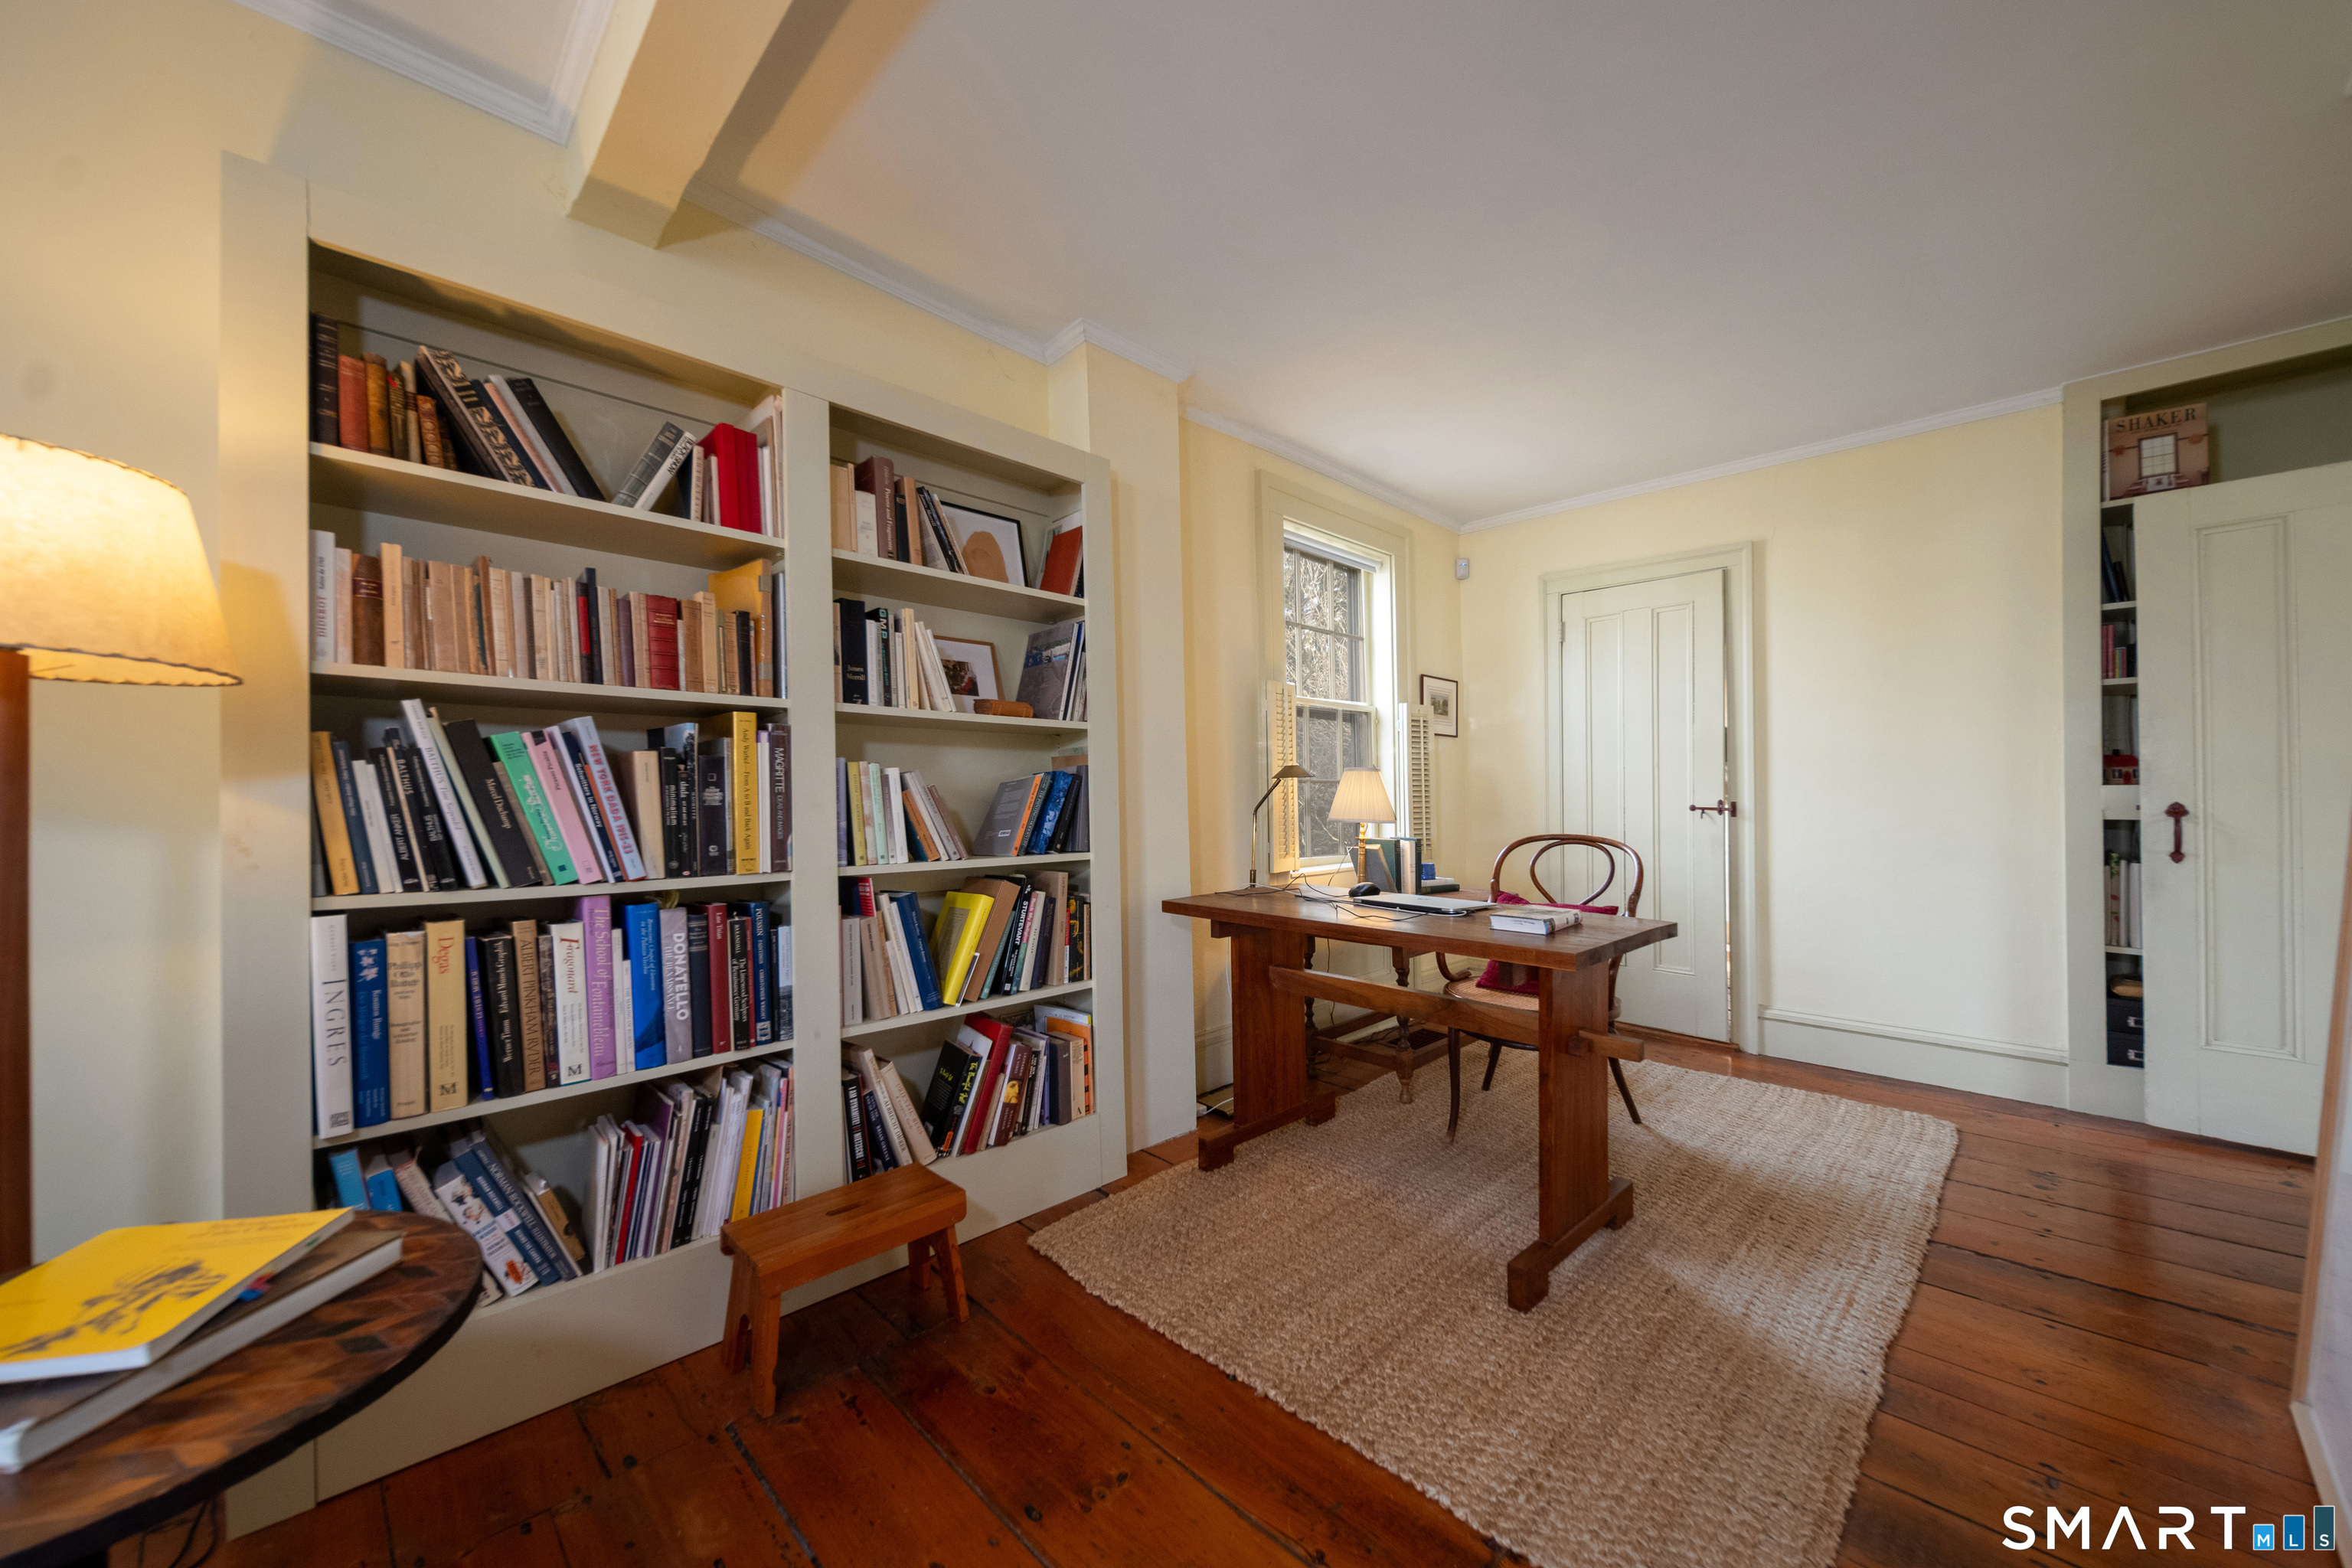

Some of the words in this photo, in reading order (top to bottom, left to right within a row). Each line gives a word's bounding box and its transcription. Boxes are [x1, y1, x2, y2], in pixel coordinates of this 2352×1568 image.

[2115, 407, 2197, 433] SHAKER
[676, 436, 694, 458] BLACK
[665, 455, 682, 475] SNOW
[883, 487, 892, 507] Poems
[924, 508, 937, 527] Merrill
[884, 520, 894, 550] Fragments
[315, 596, 327, 636] DIDEROT
[741, 727, 750, 743] Andy
[423, 746, 445, 783] BALTHUS
[540, 750, 554, 770] Picabia
[586, 743, 604, 766] NEW
[742, 744, 750, 764] Warhol
[396, 759, 413, 795] BALTHUS
[548, 769, 563, 790] Picasso
[594, 767, 613, 793] YORK
[743, 771, 751, 786] From
[775, 747, 785, 792] MAGRITTE
[485, 777, 501, 799] Marcel
[573, 763, 593, 795] Schwitters
[587, 803, 604, 828] Norway
[679, 780, 690, 797] dada
[492, 799, 514, 830] Duchamp
[603, 793, 622, 822] DADA
[668, 784, 678, 825] minimalism
[1031, 798, 1040, 817] PAINTING
[389, 813, 404, 836] ANKER
[743, 818, 752, 831] Back
[776, 821, 784, 839] IMAGES
[395, 836, 411, 861] ALBERT
[613, 823, 634, 854] 1915-23
[743, 833, 751, 850] Again
[593, 906, 609, 928] The
[714, 912, 724, 924] Late
[754, 908, 763, 936] POUSSIN
[1014, 900, 1029, 946] STURTEVANT
[1027, 912, 1033, 921] My
[714, 924, 724, 940] Titian
[1022, 921, 1031, 942] Religion
[433, 936, 455, 975] Degas
[493, 940, 508, 967] Graphik
[520, 938, 534, 976] ALBERT
[594, 930, 611, 966] School
[665, 946, 673, 958] THE
[496, 967, 508, 988] Munch
[560, 937, 580, 994] Fragonard
[597, 969, 611, 978] of
[672, 933, 688, 1021] DONATELLO
[665, 962, 677, 1011] RENAISSANCE
[730, 965, 740, 995] Renaissance
[739, 969, 748, 996] Limewood
[498, 989, 509, 1013] Edvard
[521, 979, 538, 1034] PINKHAM
[732, 996, 740, 1021] Germany
[322, 978, 347, 1067] INGRES
[592, 980, 610, 1057] Fontainebleau
[502, 1039, 513, 1062] Werner
[524, 1037, 541, 1076] RYDER
[567, 1063, 582, 1077] M
[968, 1060, 979, 1072] The
[1018, 1052, 1027, 1076] LEONARDO
[439, 1082, 457, 1096] M
[848, 1089, 857, 1098] AM
[848, 1098, 861, 1125] DYNAMITE!
[895, 1082, 914, 1116] ORIENTAL
[911, 1117, 923, 1135] RUGS
[1001, 1106, 1010, 1131] ISAACSON
[1005, 1109, 1014, 1128] WALTER
[883, 1099, 899, 1131] ALBRECHT
[893, 1130, 908, 1152] DÜRER
[852, 1132, 864, 1159] NIETZSCHE
[874, 1125, 884, 1142] BRIAN
[880, 1141, 890, 1161] GREENE
[475, 1174, 492, 1194] NORMAN
[487, 1161, 515, 1197] NORMAN
[507, 1190, 538, 1230] ROCKWELL
